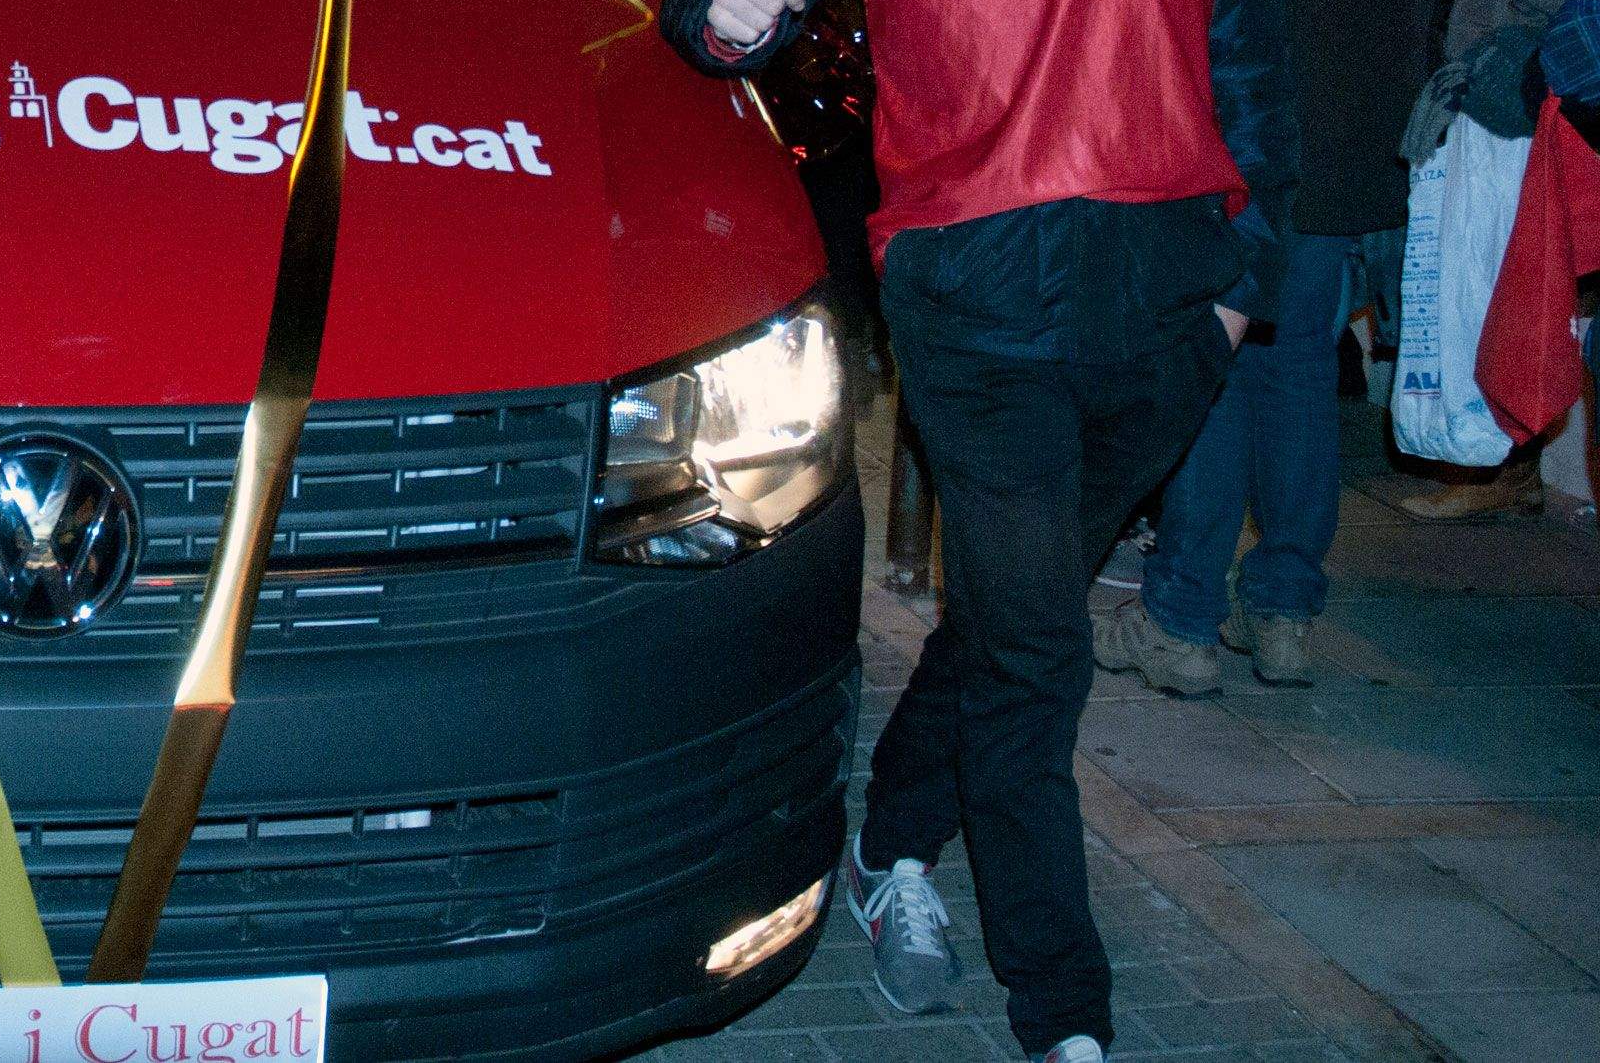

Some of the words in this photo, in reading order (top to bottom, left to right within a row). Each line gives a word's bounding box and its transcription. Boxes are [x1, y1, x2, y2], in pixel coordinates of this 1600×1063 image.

[1404, 371, 1441, 390] AL
[24, 1008, 43, 1063] i
[74, 1002, 314, 1063] Cugat
